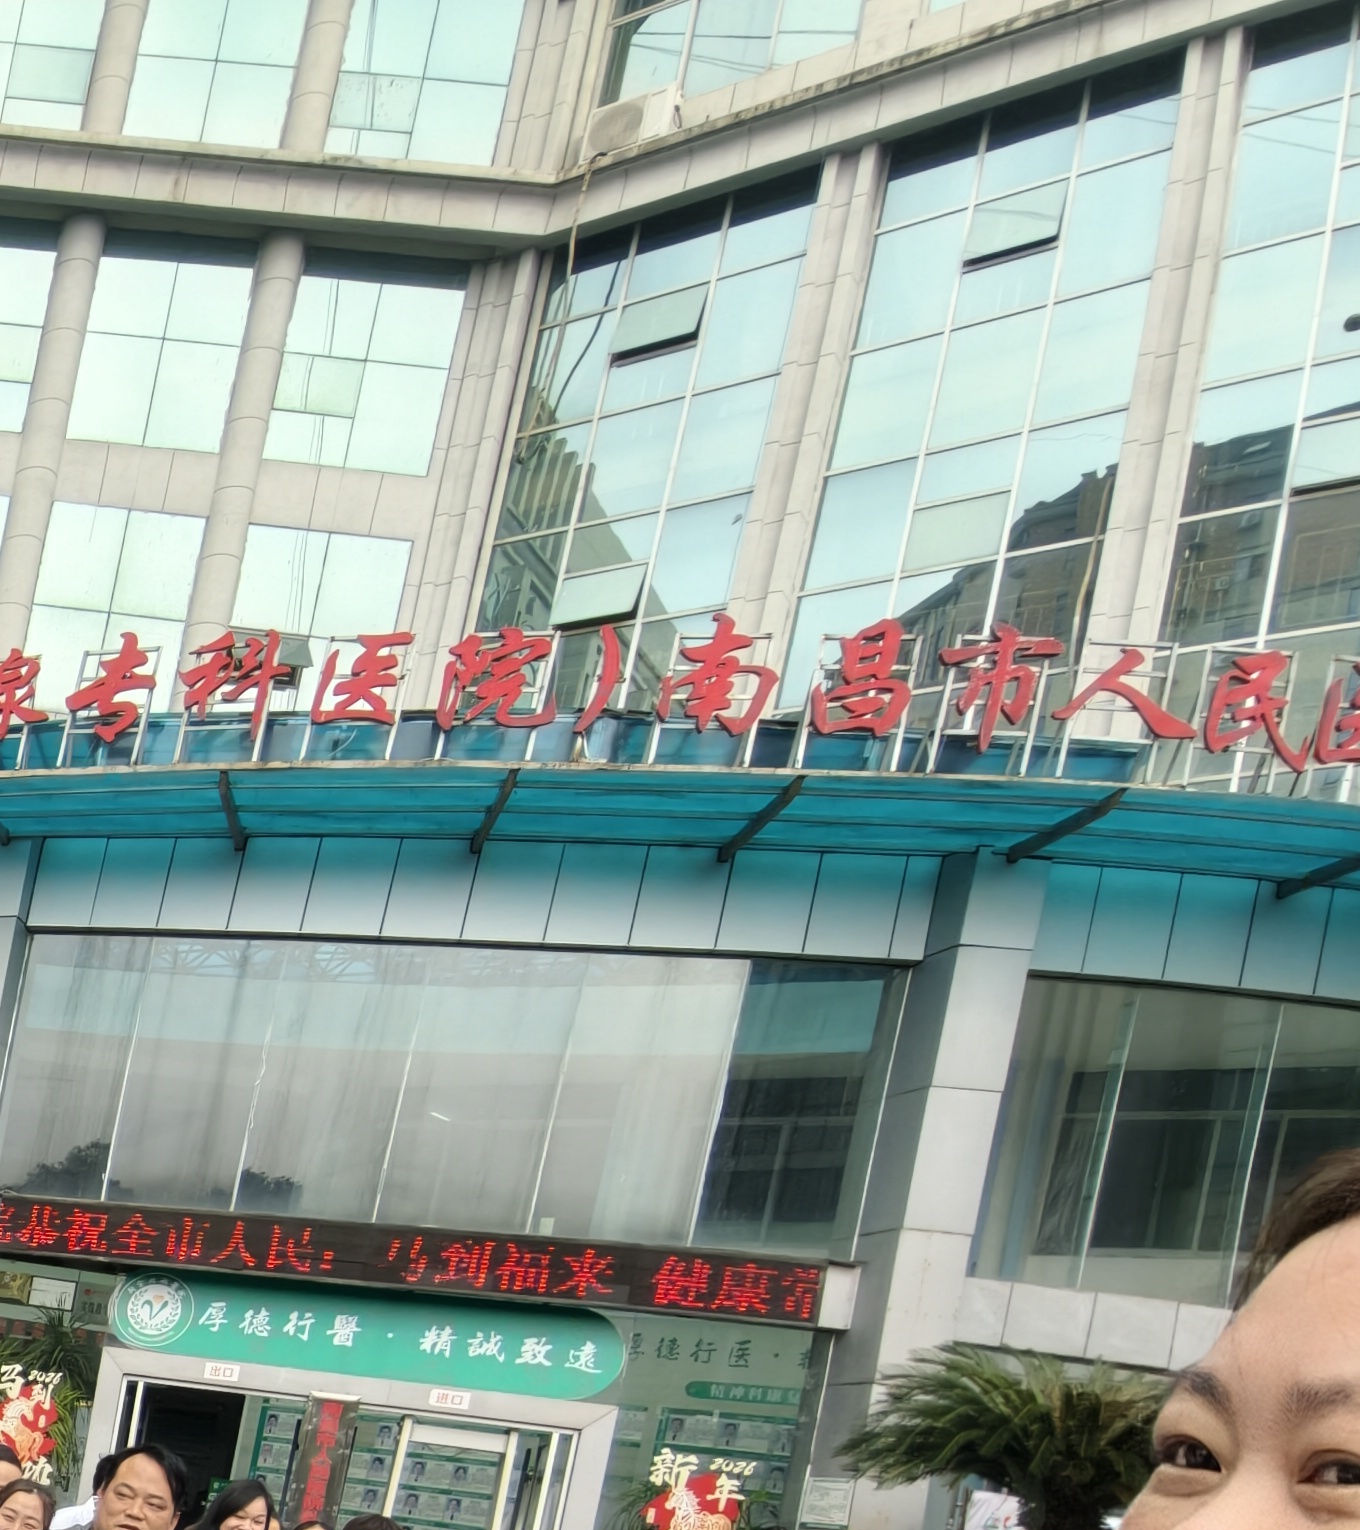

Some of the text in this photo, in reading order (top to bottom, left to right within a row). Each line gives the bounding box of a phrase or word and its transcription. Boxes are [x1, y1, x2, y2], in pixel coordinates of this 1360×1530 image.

[28, 1369, 63, 1384] 2026
[209, 1365, 234, 1377] 出口
[434, 1391, 465, 1406] 进口
[709, 1457, 758, 1476] 2026
